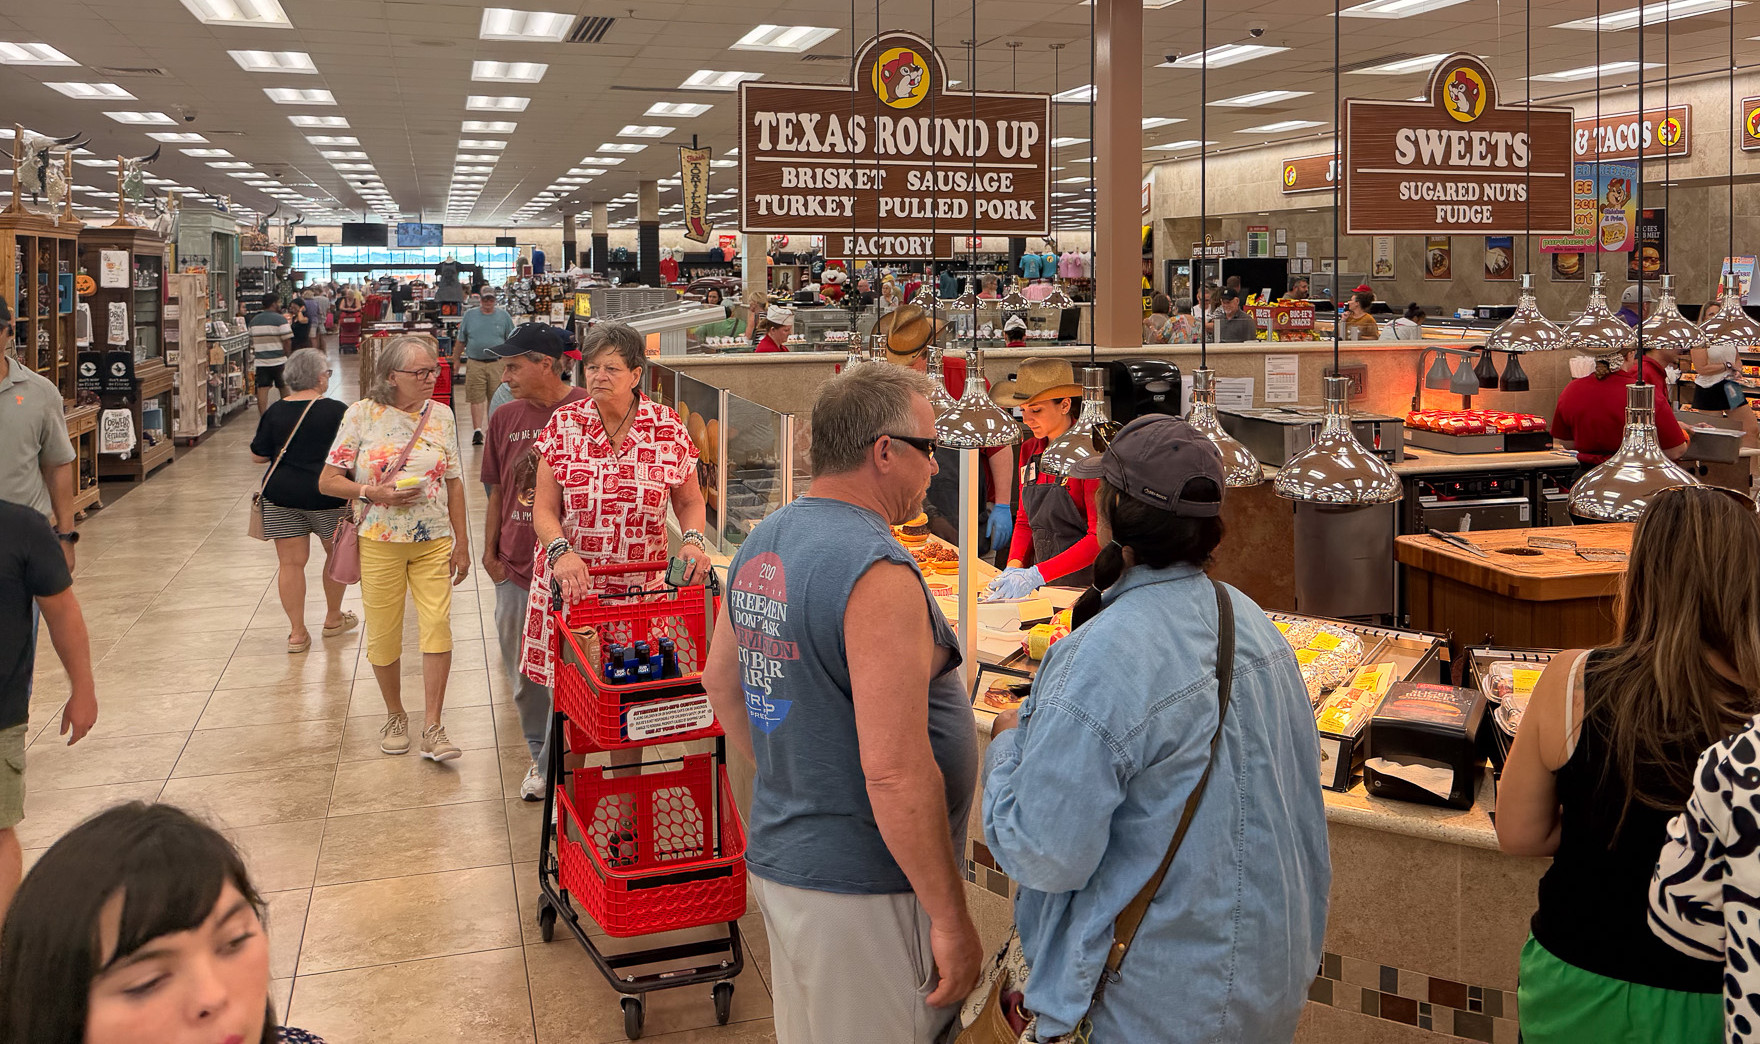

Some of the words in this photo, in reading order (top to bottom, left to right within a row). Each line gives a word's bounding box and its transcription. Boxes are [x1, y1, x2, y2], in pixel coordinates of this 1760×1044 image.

[754, 111, 867, 154] TEXAS
[874, 116, 989, 157] ROUND
[996, 120, 1039, 158] UP
[1575, 130, 1589, 155] &
[1594, 121, 1652, 153] TACOS
[1395, 128, 1531, 168] SWEETS
[690, 163, 701, 216] TORTILLAS
[782, 167, 887, 190] BRISKET
[907, 171, 1013, 192] SAUSAGE
[1400, 182, 1478, 201] SUGARED
[1483, 184, 1527, 201] NUTS
[756, 194, 857, 216] TURKEY
[879, 198, 968, 218] PULLED
[975, 200, 1036, 220] PORK
[1435, 204, 1492, 224] FUDGE
[843, 236, 934, 255] FACTORY
[1542, 237, 1584, 248] purchase
[510, 432, 520, 442] YOU
[522, 430, 530, 440] ARE
